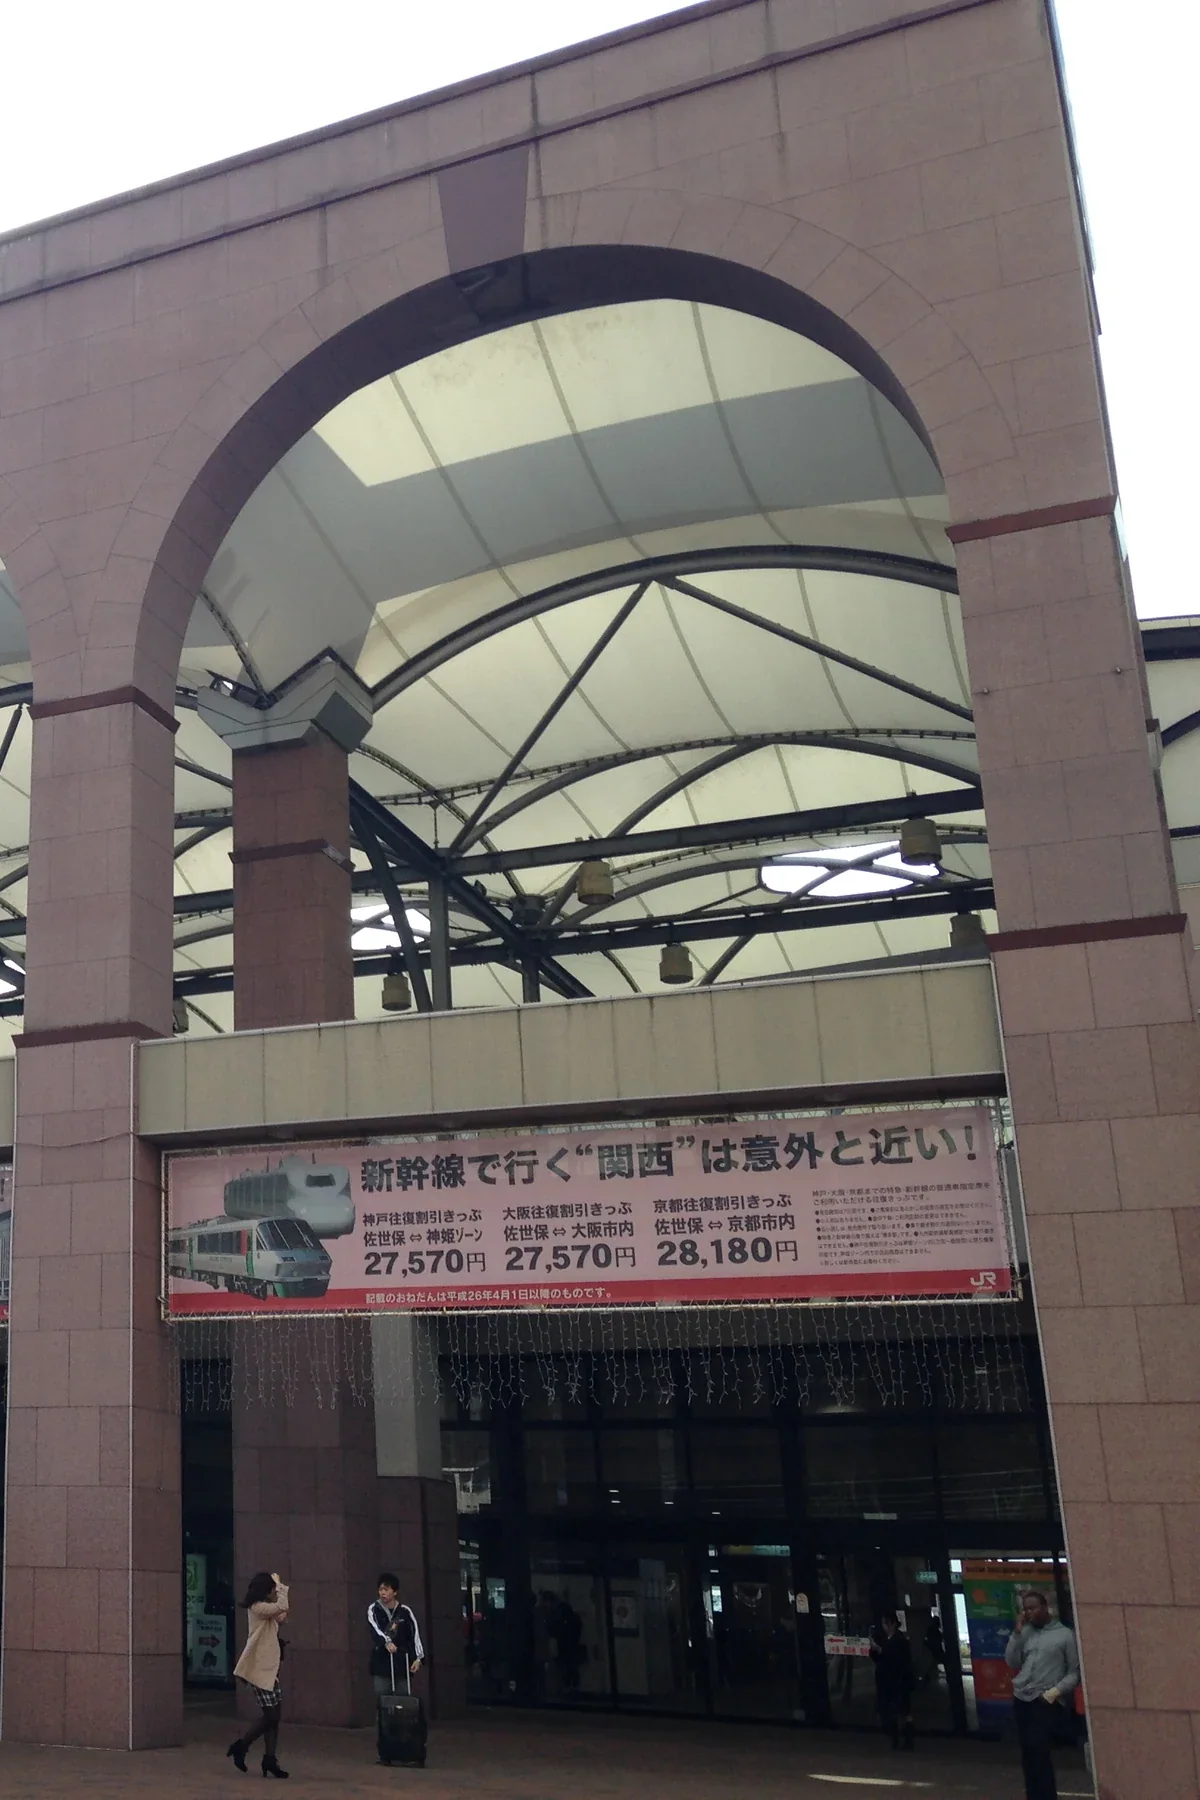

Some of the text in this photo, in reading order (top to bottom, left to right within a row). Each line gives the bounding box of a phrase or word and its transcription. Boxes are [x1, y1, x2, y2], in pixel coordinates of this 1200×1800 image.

[503, 1202, 632, 1221] 大阪往復割引きっぷ
[653, 1194, 792, 1213] 京都往復割引きっぷ
[363, 1209, 483, 1227] 神戸往復割引きっぷ
[654, 1219, 703, 1236] 佐世保
[727, 1213, 796, 1231] 京都市内
[363, 1231, 405, 1247] 佐世保
[504, 1221, 634, 1242] 佐世保 大阪市内
[505, 1243, 636, 1274] 27,570円
[657, 1237, 799, 1269] 28,180円
[364, 1249, 486, 1278] 27,570円
[970, 1271, 997, 1286] JR
[365, 1287, 612, 1305] 記載のおねだんは平成26年4月1日以降のものです。
